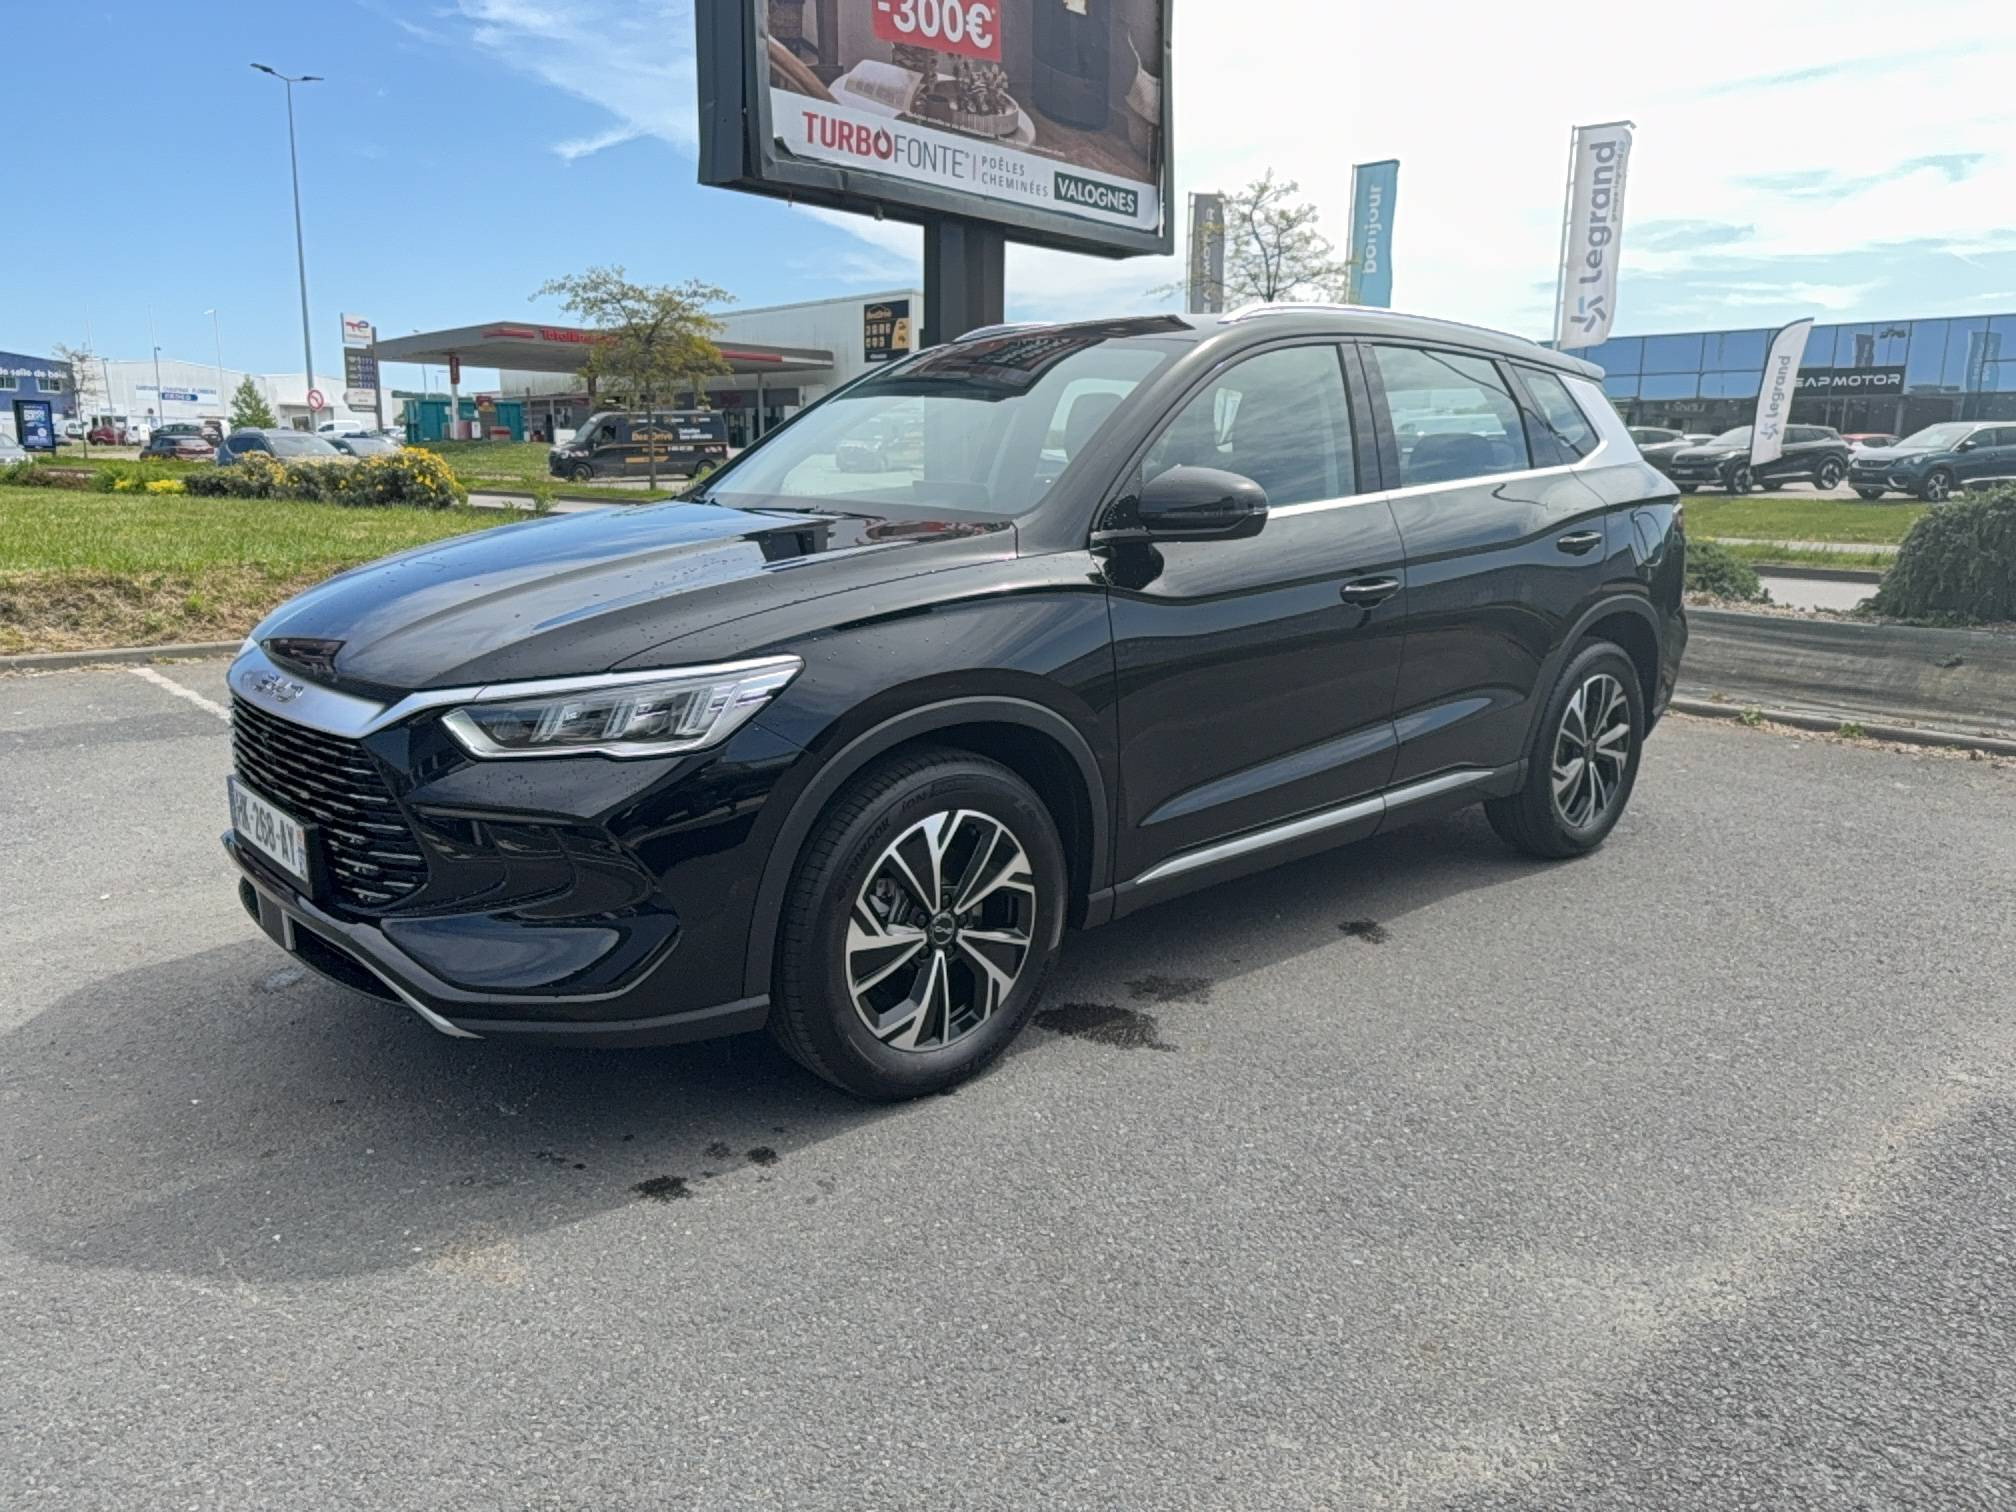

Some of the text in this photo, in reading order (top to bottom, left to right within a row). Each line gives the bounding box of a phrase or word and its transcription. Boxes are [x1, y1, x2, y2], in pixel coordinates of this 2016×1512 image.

[981, 155, 1025, 177] POÊLES
[981, 171, 1049, 198] CHEMINÉES
[1056, 176, 1136, 214] VALOGNES
[1362, 185, 1384, 274] bonjour
[1794, 373, 1901, 388] EAPMOTOR
